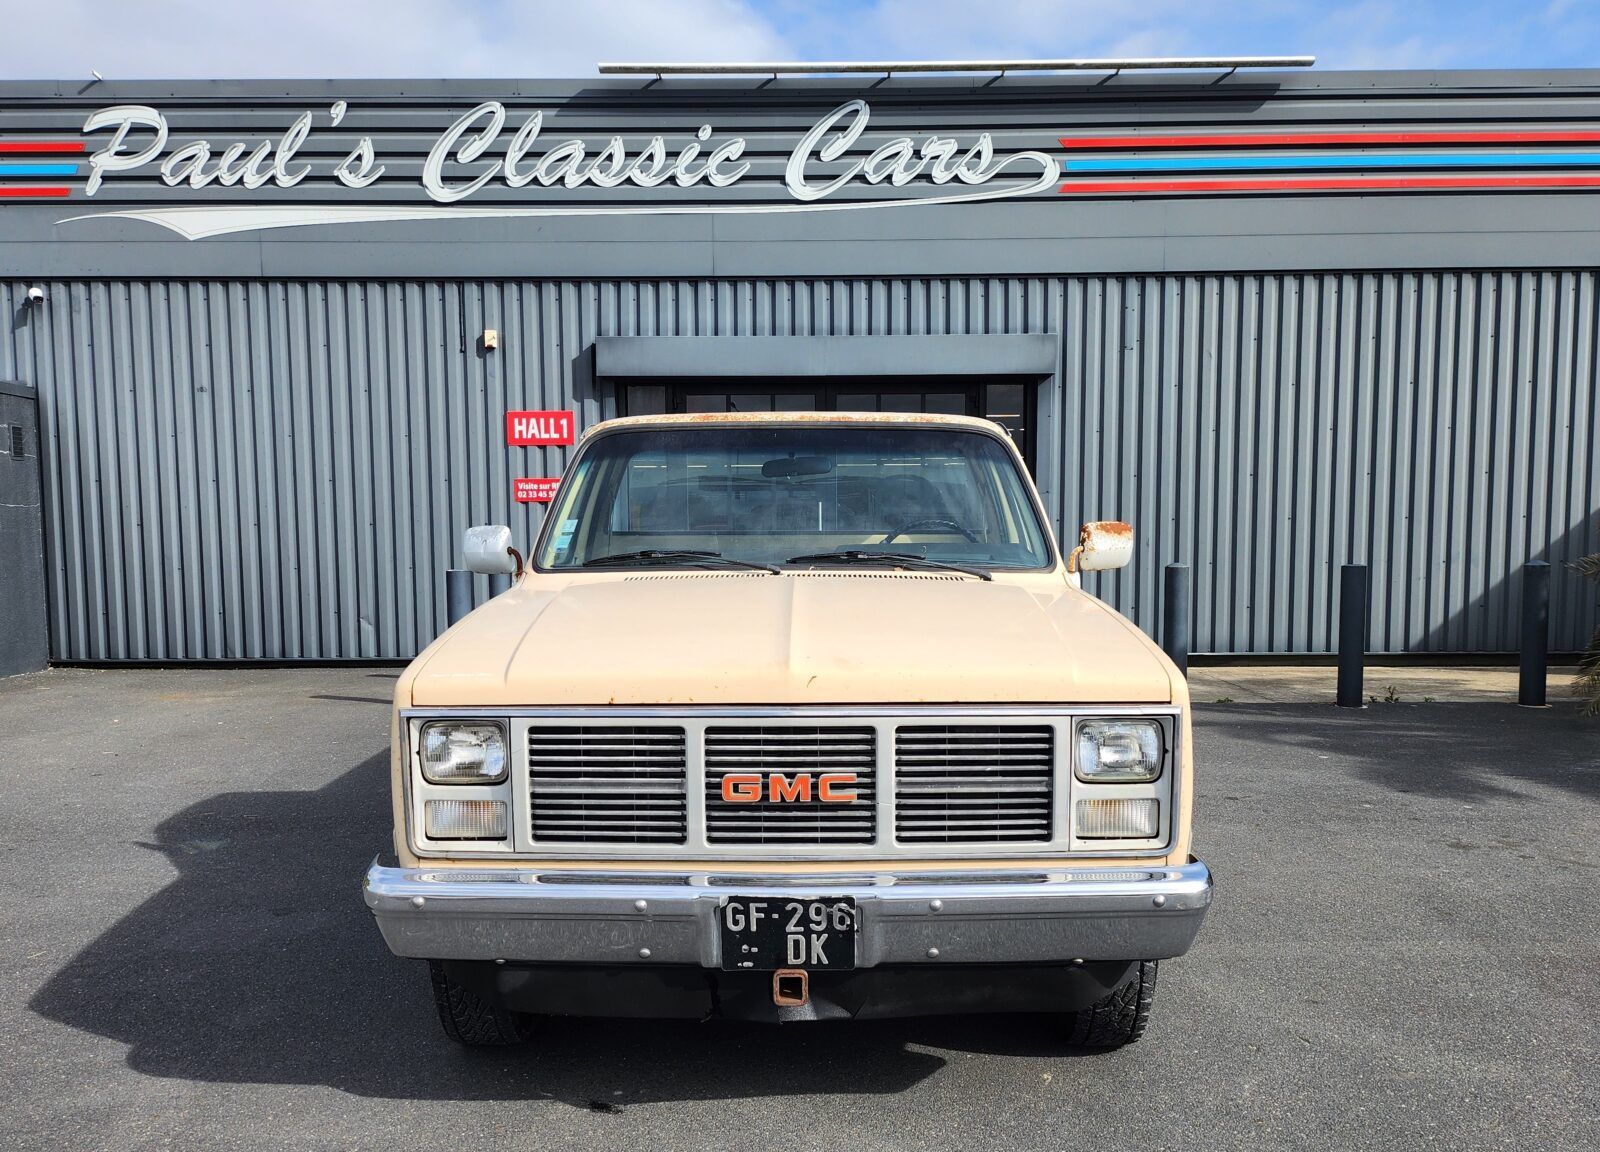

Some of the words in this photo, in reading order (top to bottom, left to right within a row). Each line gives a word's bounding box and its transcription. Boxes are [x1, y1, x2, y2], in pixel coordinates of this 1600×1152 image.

[82, 100, 386, 196] Paul's
[422, 101, 751, 203] Classic
[785, 99, 1061, 201] Cars
[517, 482, 538, 490] Visite
[721, 773, 858, 803] GMC
[787, 933, 829, 965] DK
